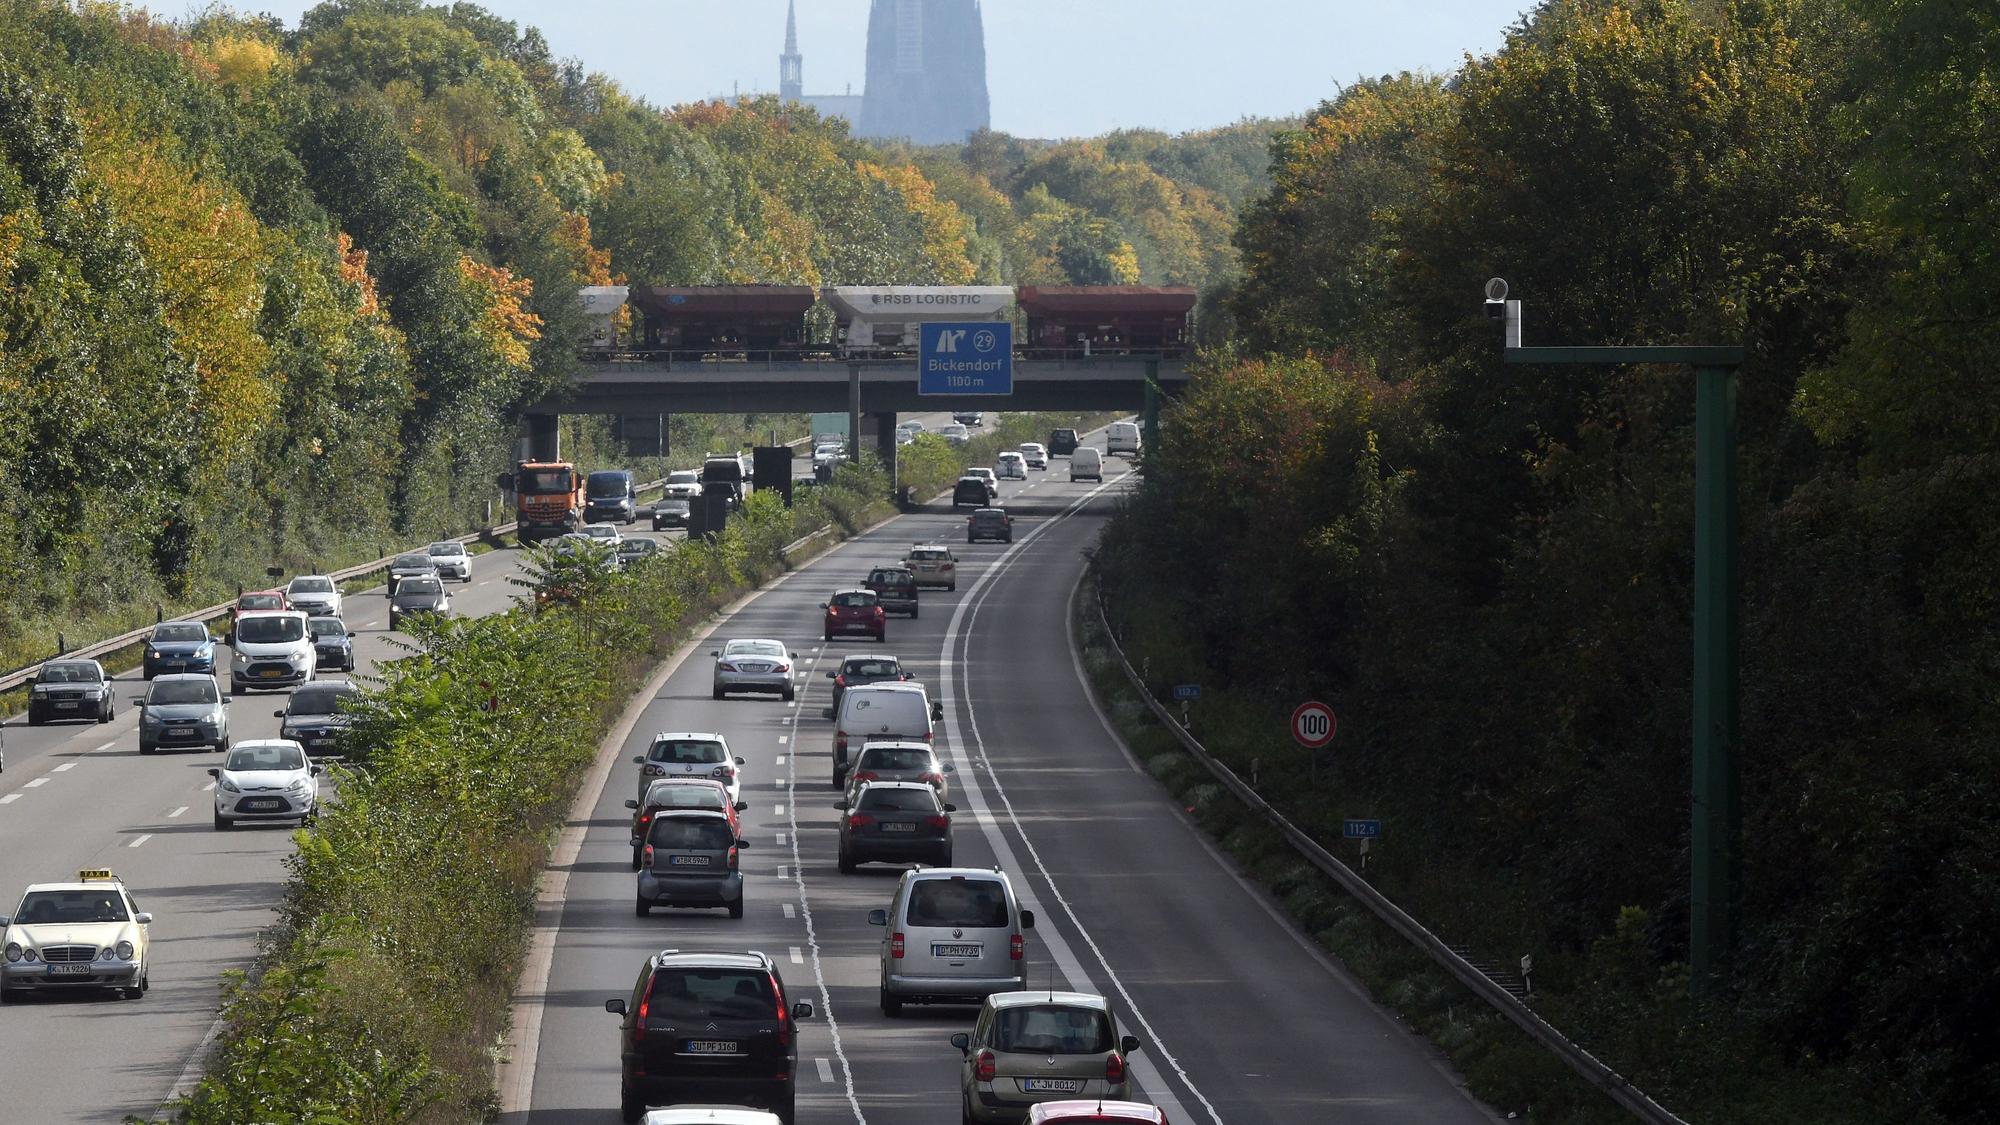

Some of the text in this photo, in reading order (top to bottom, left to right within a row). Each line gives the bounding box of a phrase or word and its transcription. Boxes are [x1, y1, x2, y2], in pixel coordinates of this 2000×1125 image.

[883, 294, 981, 304] RSB LOGISTIC
[976, 335, 993, 347] 29
[928, 359, 1002, 371] Bickendorf
[947, 376, 984, 386] 1100 m
[1301, 714, 1328, 735] 100
